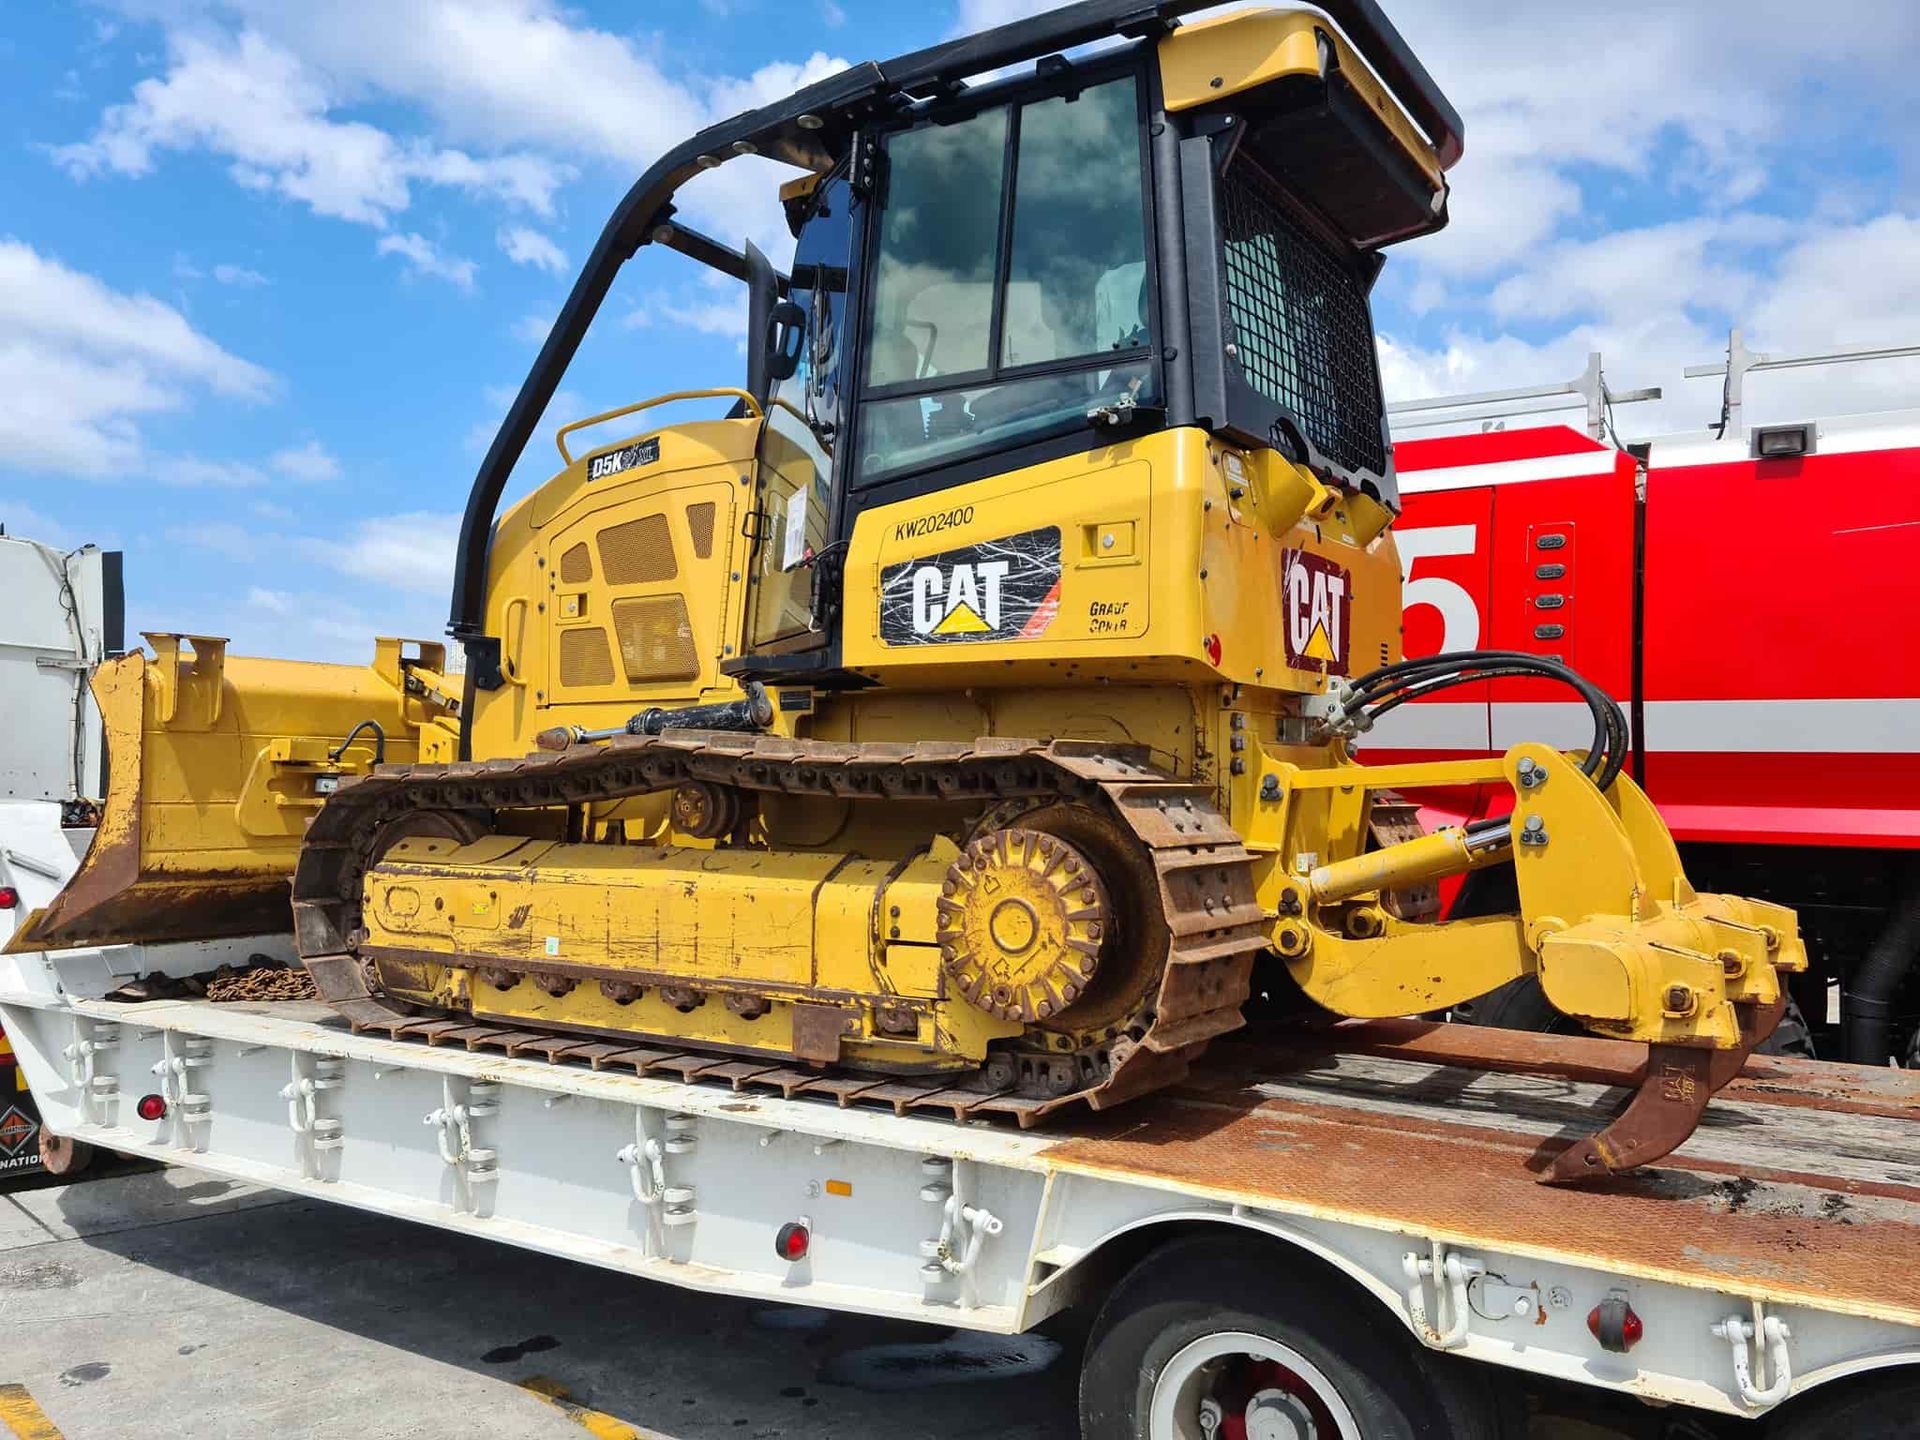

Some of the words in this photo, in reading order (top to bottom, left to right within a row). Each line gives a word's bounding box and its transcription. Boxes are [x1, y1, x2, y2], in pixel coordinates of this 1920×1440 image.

[895, 506, 974, 541] KW202400
[912, 560, 1009, 634] CAT
[1290, 563, 1345, 662] CAT
